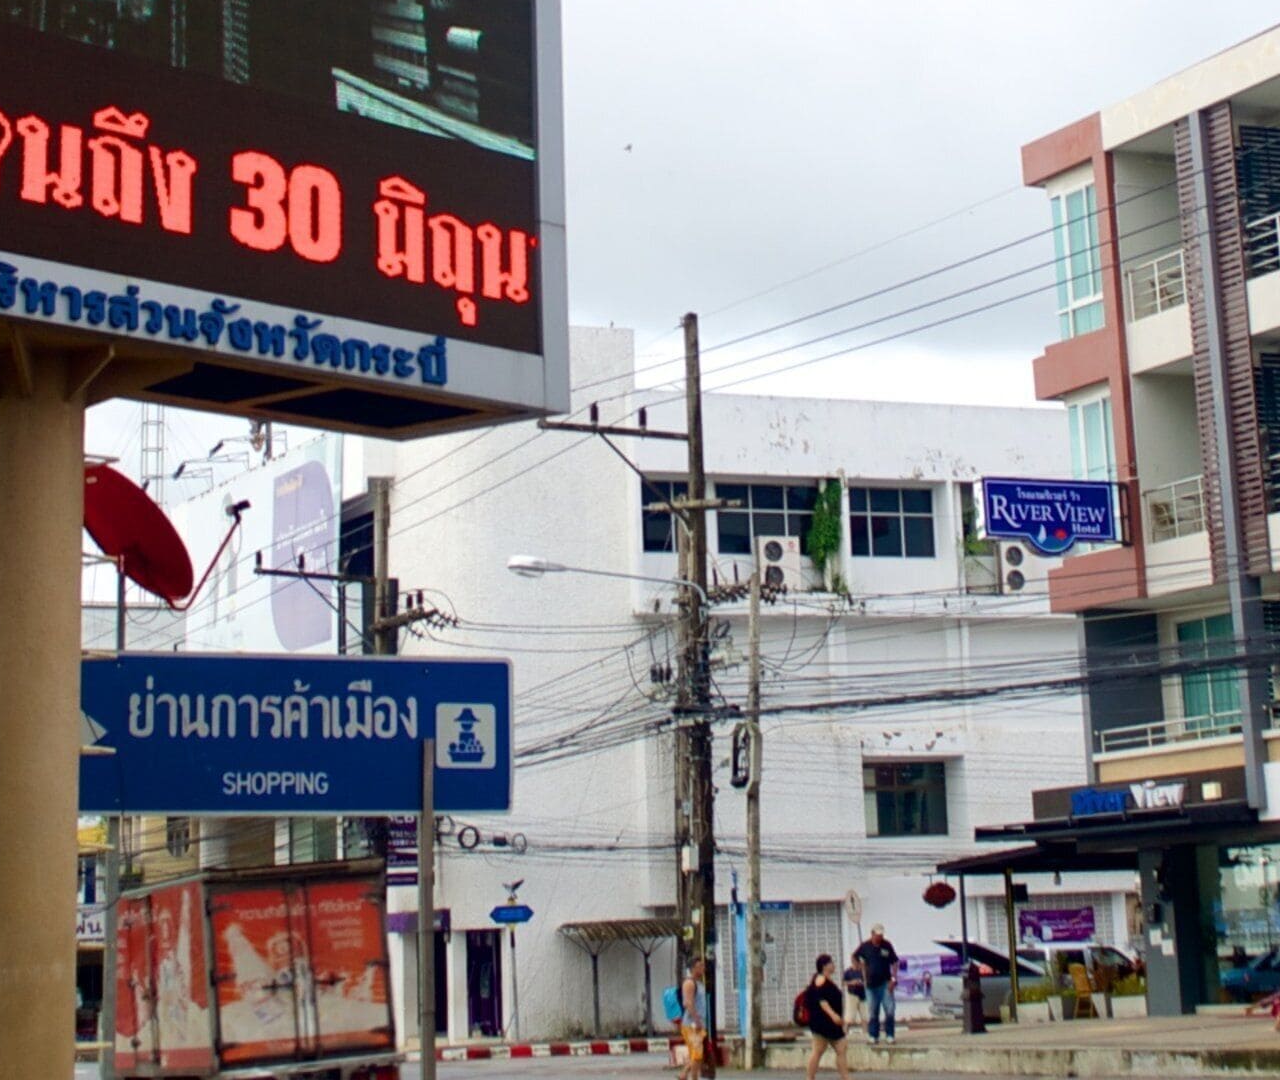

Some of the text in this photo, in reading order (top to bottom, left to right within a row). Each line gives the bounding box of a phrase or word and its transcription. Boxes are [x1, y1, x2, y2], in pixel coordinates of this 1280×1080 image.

[229, 150, 342, 263] 30
[373, 175, 539, 327] มิถุน
[991, 494, 1106, 528] RIVER VIEW
[1072, 523, 1101, 535] Hotel
[128, 674, 419, 740] ย่านการค้าเมือง
[222, 772, 330, 796] SHOPPING
[1129, 780, 1184, 809] View
